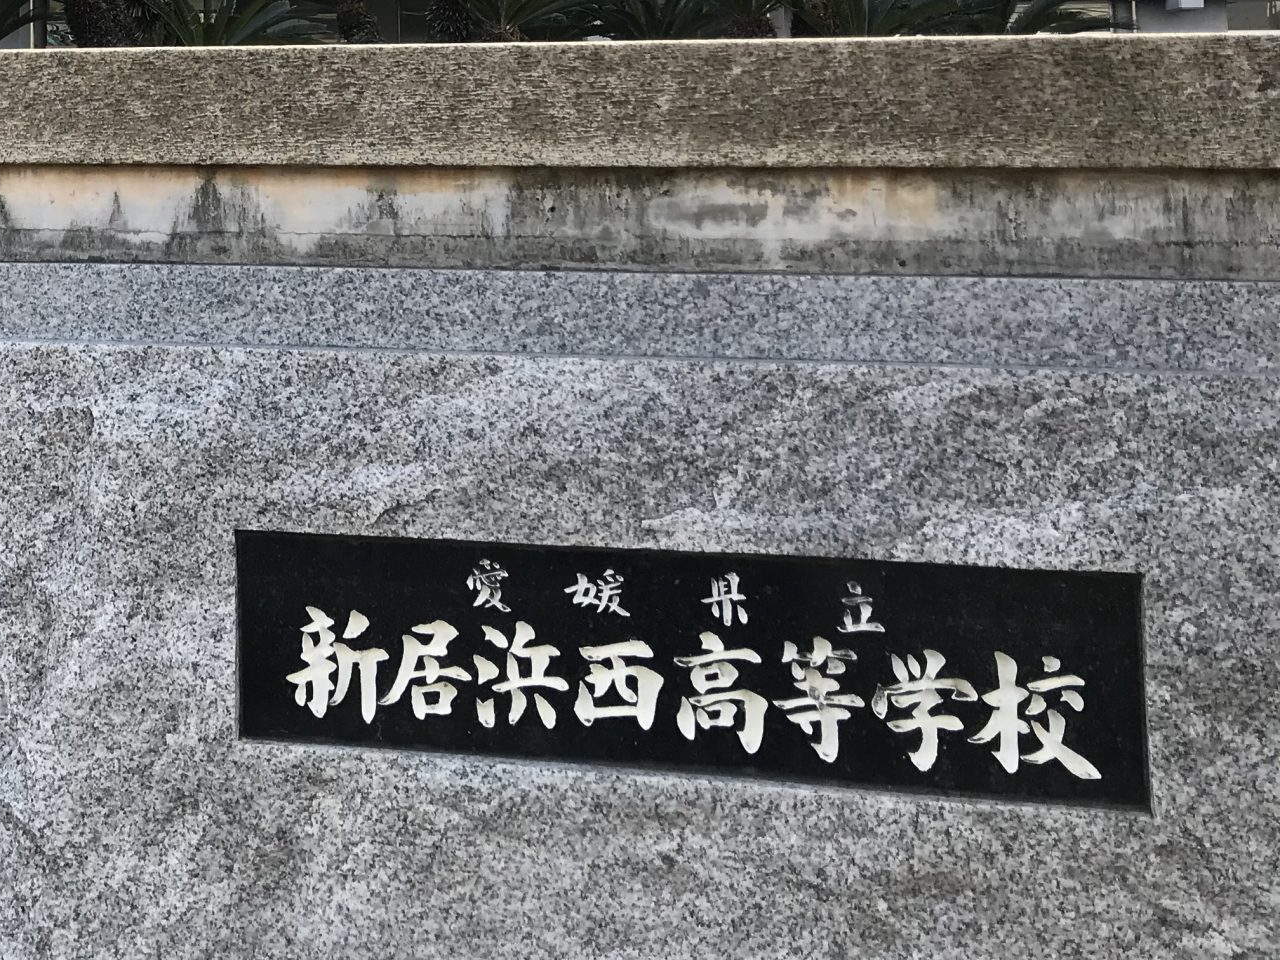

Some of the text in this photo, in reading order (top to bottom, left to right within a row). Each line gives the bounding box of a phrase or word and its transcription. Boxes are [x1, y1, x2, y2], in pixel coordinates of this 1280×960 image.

[466, 558, 885, 634] 愛媛県立
[286, 606, 1101, 781] 新居浜西高等学校
